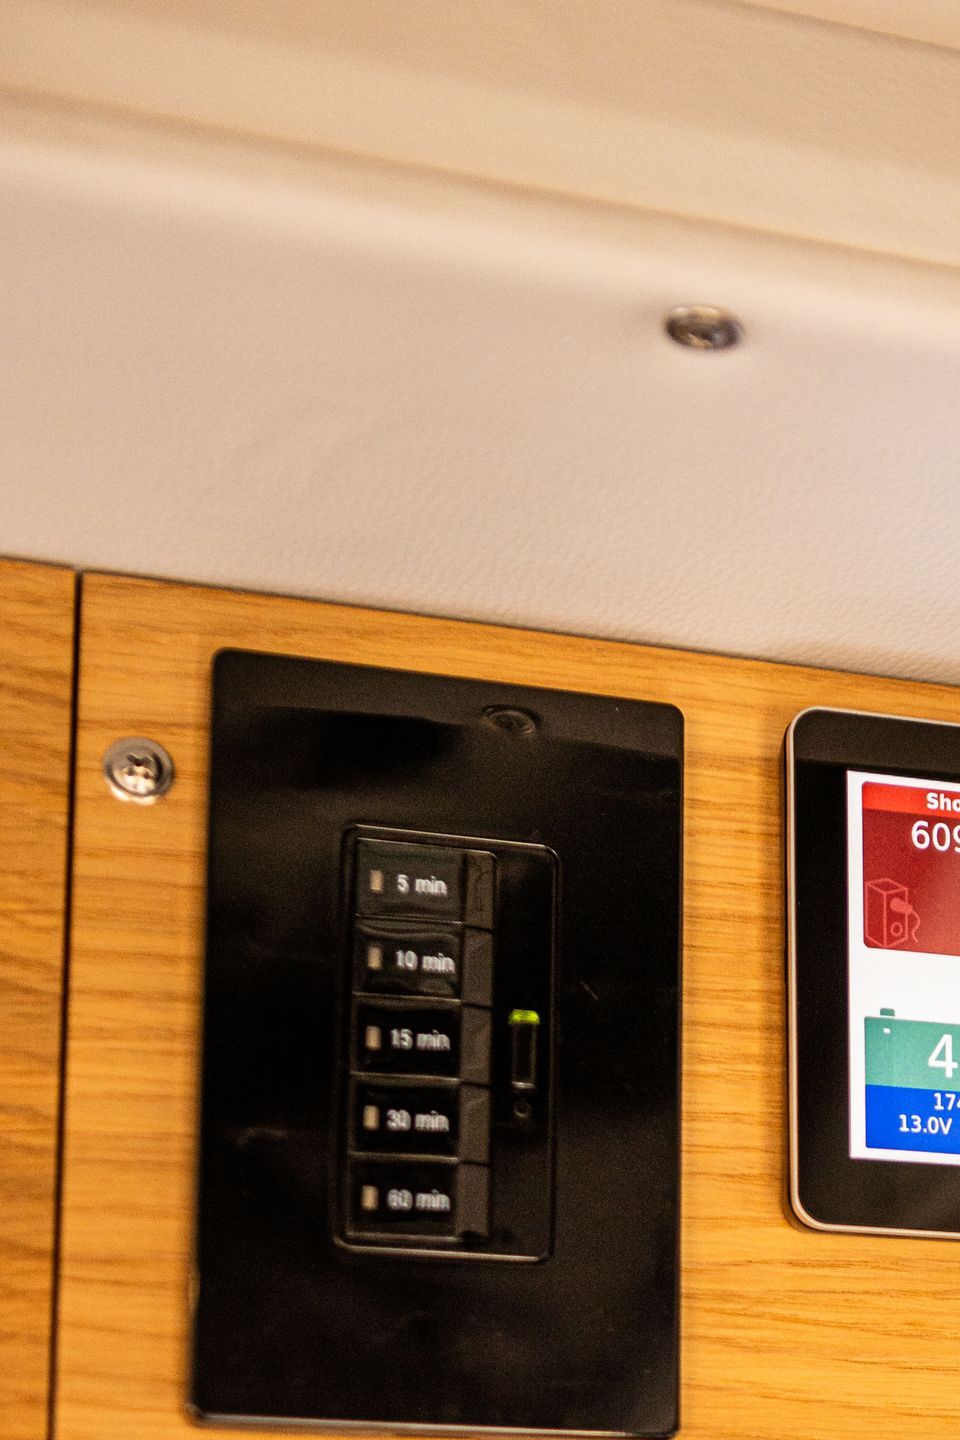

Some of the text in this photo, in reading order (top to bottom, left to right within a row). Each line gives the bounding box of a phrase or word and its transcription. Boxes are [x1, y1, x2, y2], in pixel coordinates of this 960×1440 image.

[396, 874, 448, 896] 5 min
[396, 950, 456, 974] 10 min
[390, 1028, 451, 1051] 15 min
[386, 1109, 450, 1132] 30 min
[898, 1114, 953, 1135] 13.0V
[414, 1189, 451, 1212] min
